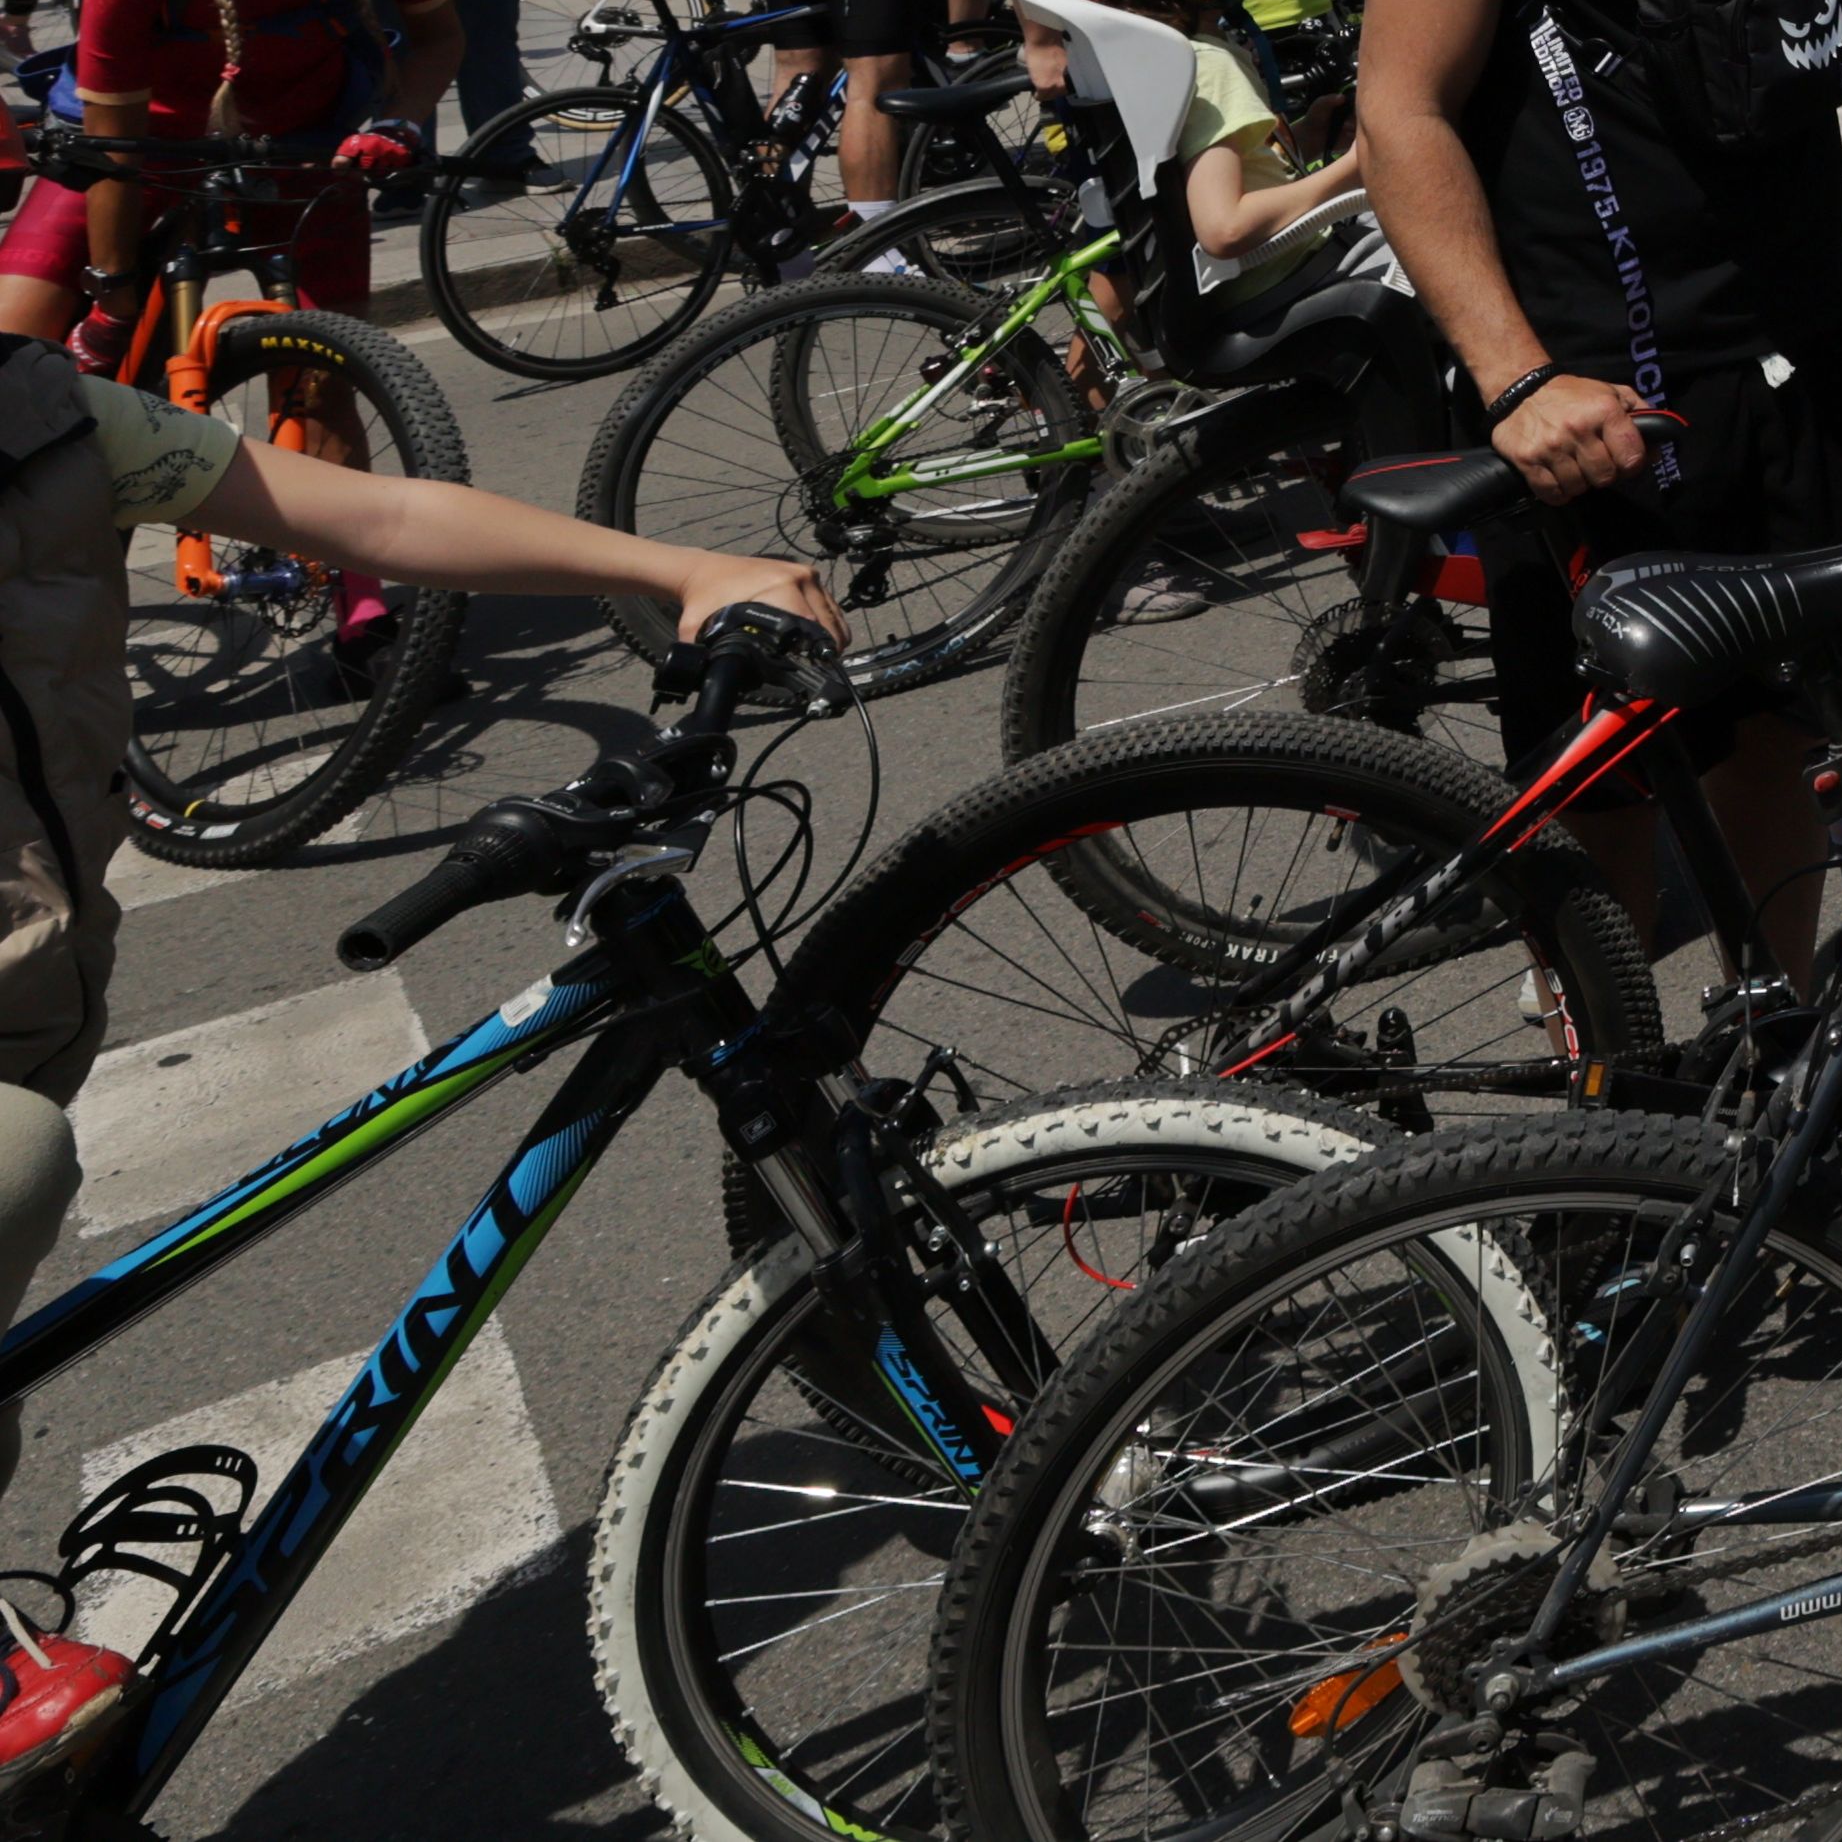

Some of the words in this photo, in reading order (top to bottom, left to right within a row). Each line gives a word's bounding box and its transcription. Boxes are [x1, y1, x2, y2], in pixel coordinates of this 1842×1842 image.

[1530, 34, 1571, 108] EDITION
[1543, 25, 1584, 102] LIMITED
[260, 336, 345, 365] MAXXIS
[1248, 854, 1462, 1050] SPARK
[165, 1173, 535, 1683] SPRINT
